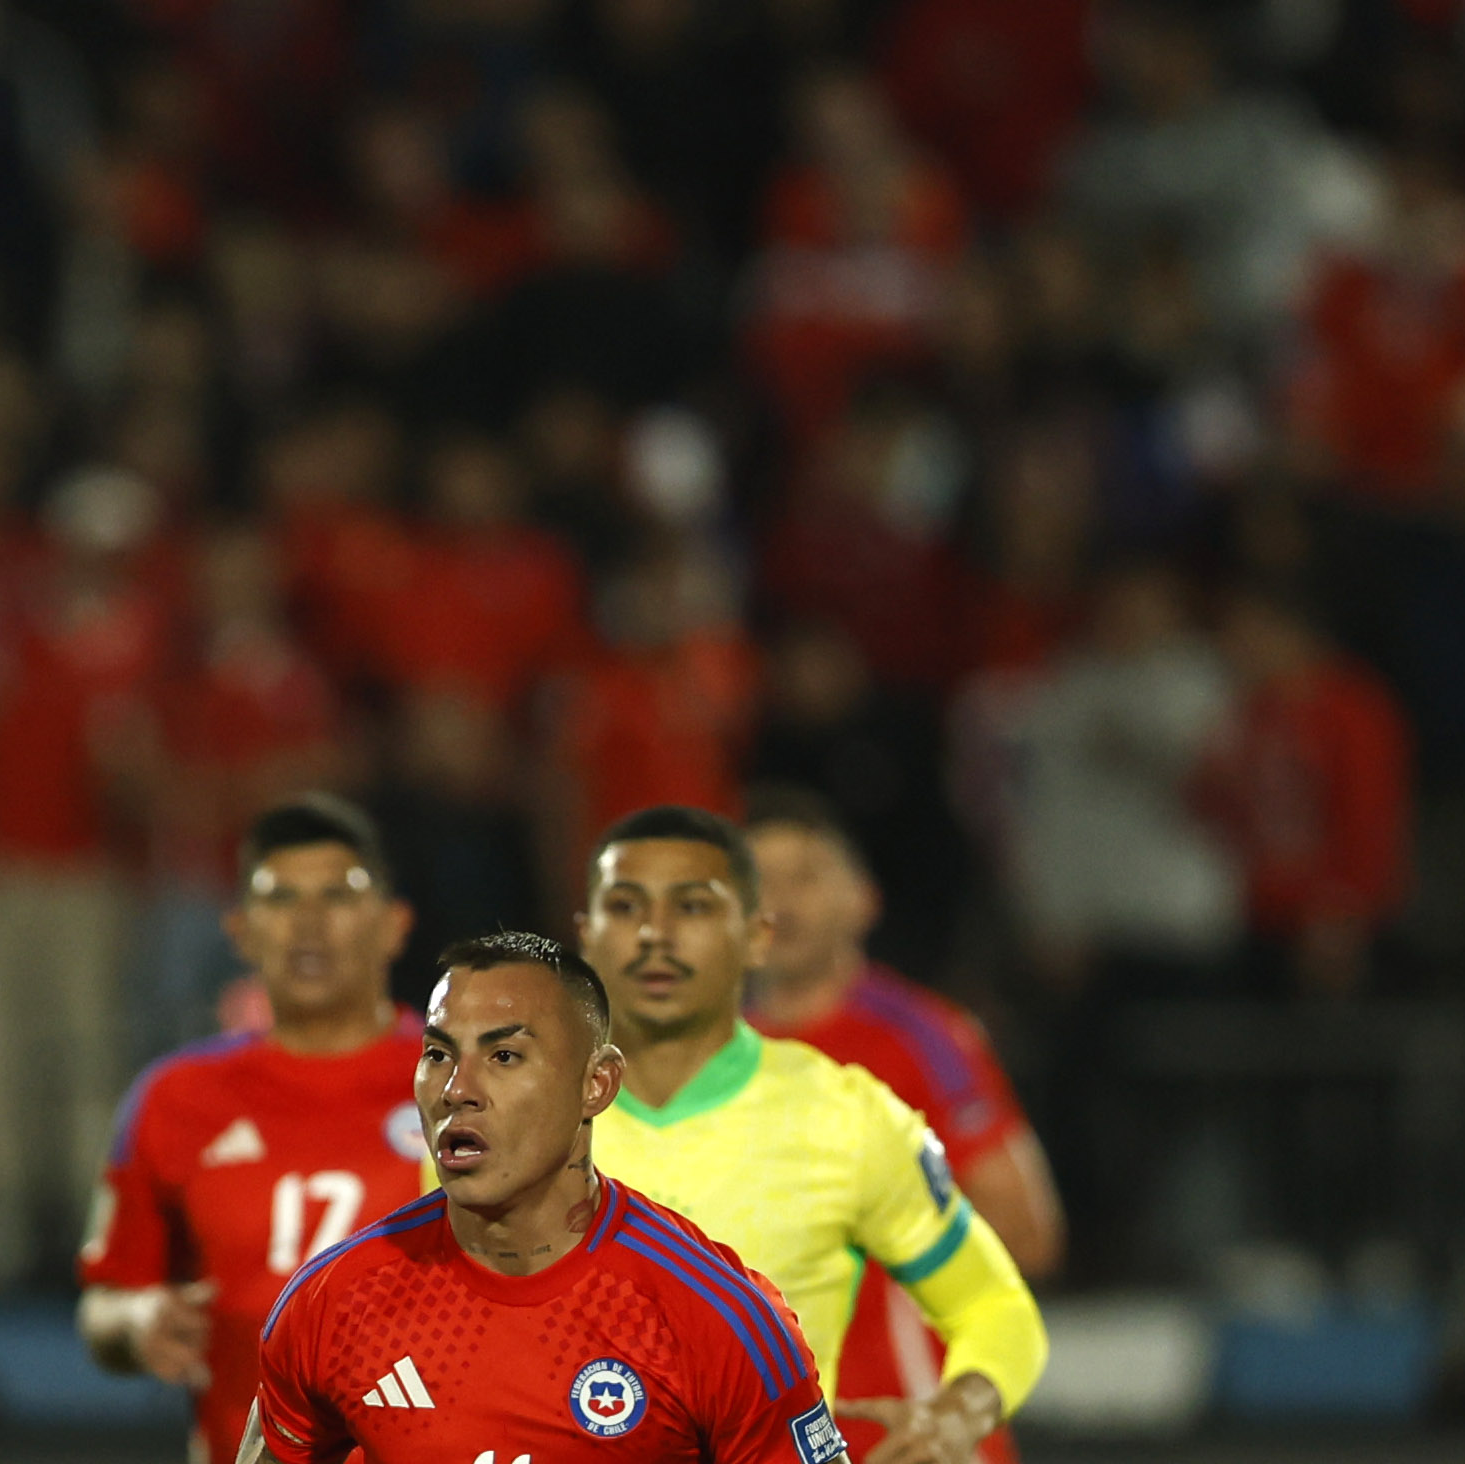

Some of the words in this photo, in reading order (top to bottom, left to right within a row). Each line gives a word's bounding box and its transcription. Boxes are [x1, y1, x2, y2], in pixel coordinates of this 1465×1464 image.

[612, 1362, 624, 1374] DE
[586, 1421, 599, 1433] DE
[603, 1422, 628, 1436] CHILE
